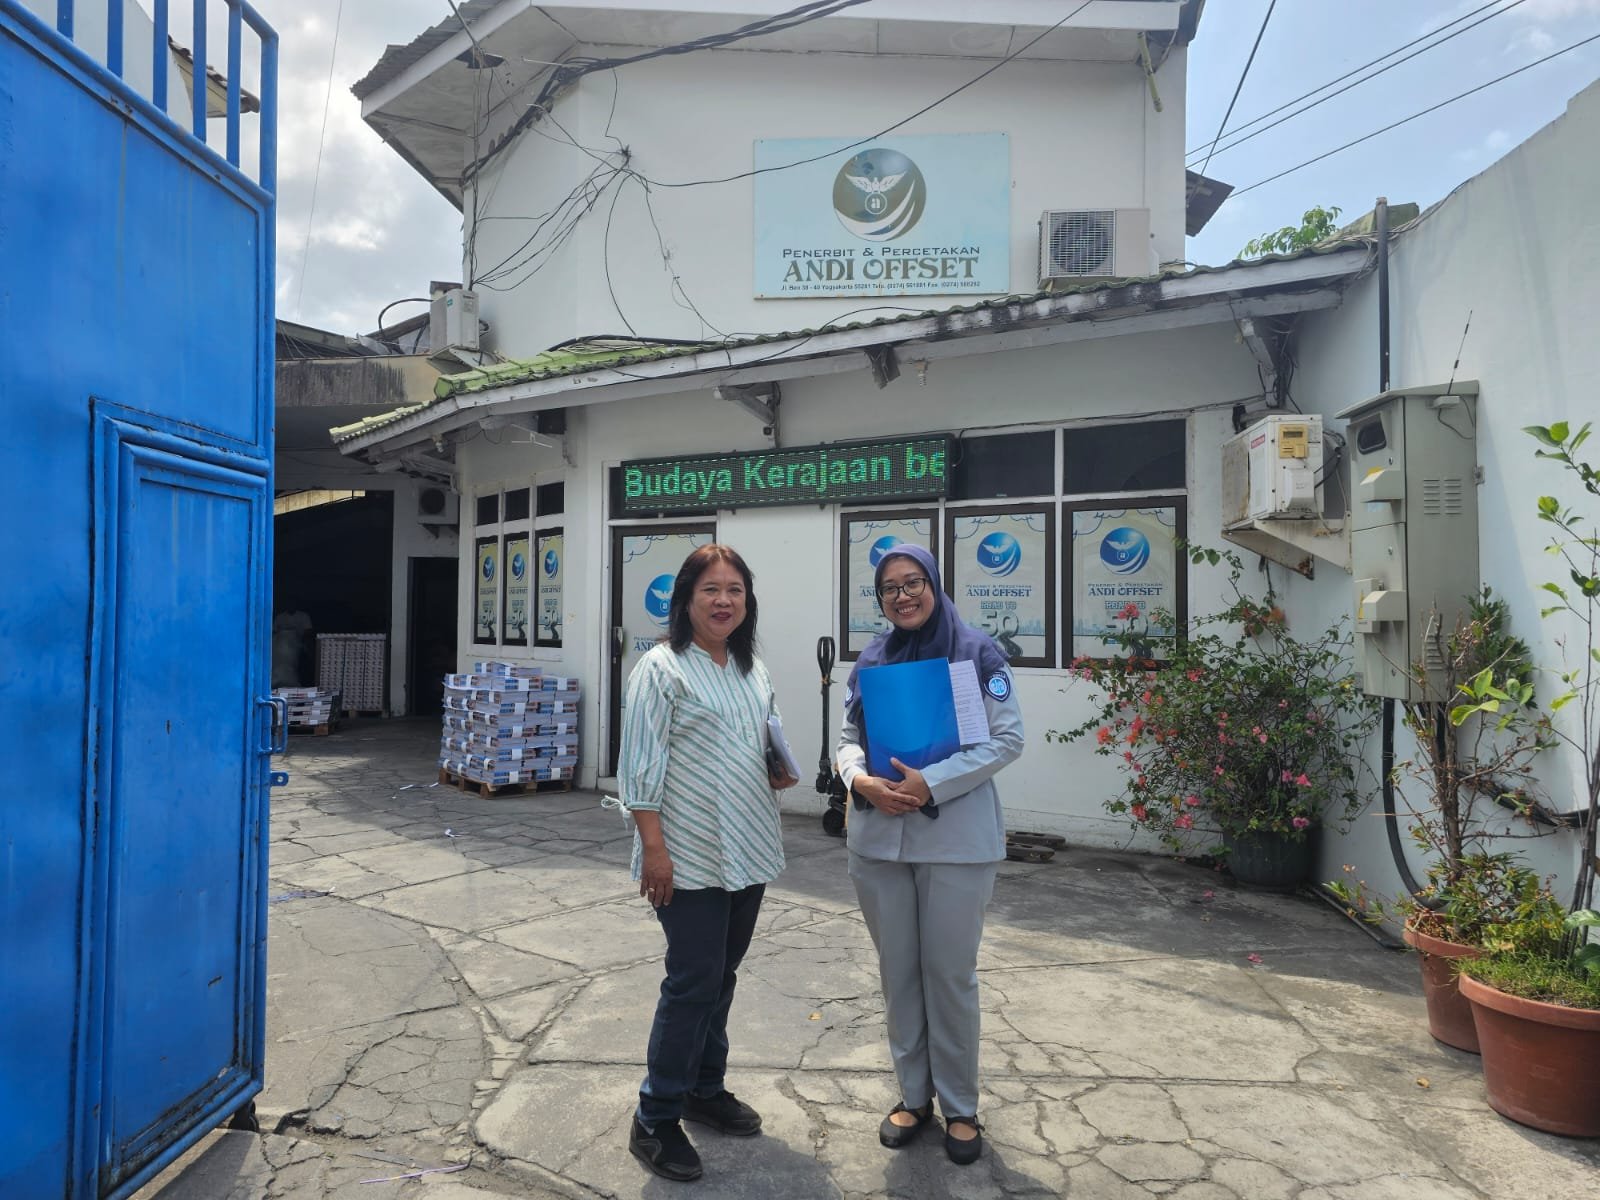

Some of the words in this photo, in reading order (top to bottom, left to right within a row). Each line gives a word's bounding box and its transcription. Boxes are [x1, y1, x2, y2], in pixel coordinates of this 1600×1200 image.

[783, 249, 855, 258] PENERBIT
[863, 248, 874, 257] &
[882, 247, 980, 256] PERCETAKAN
[783, 259, 855, 282] ANDI
[863, 257, 979, 280] OFFSET
[626, 466, 732, 499] Budaya
[744, 451, 891, 492] Kerajaan
[966, 588, 990, 597] ANDI
[992, 588, 1032, 597] OFFSET
[1088, 587, 1115, 596] ANDI
[1118, 587, 1163, 596] OFFSET
